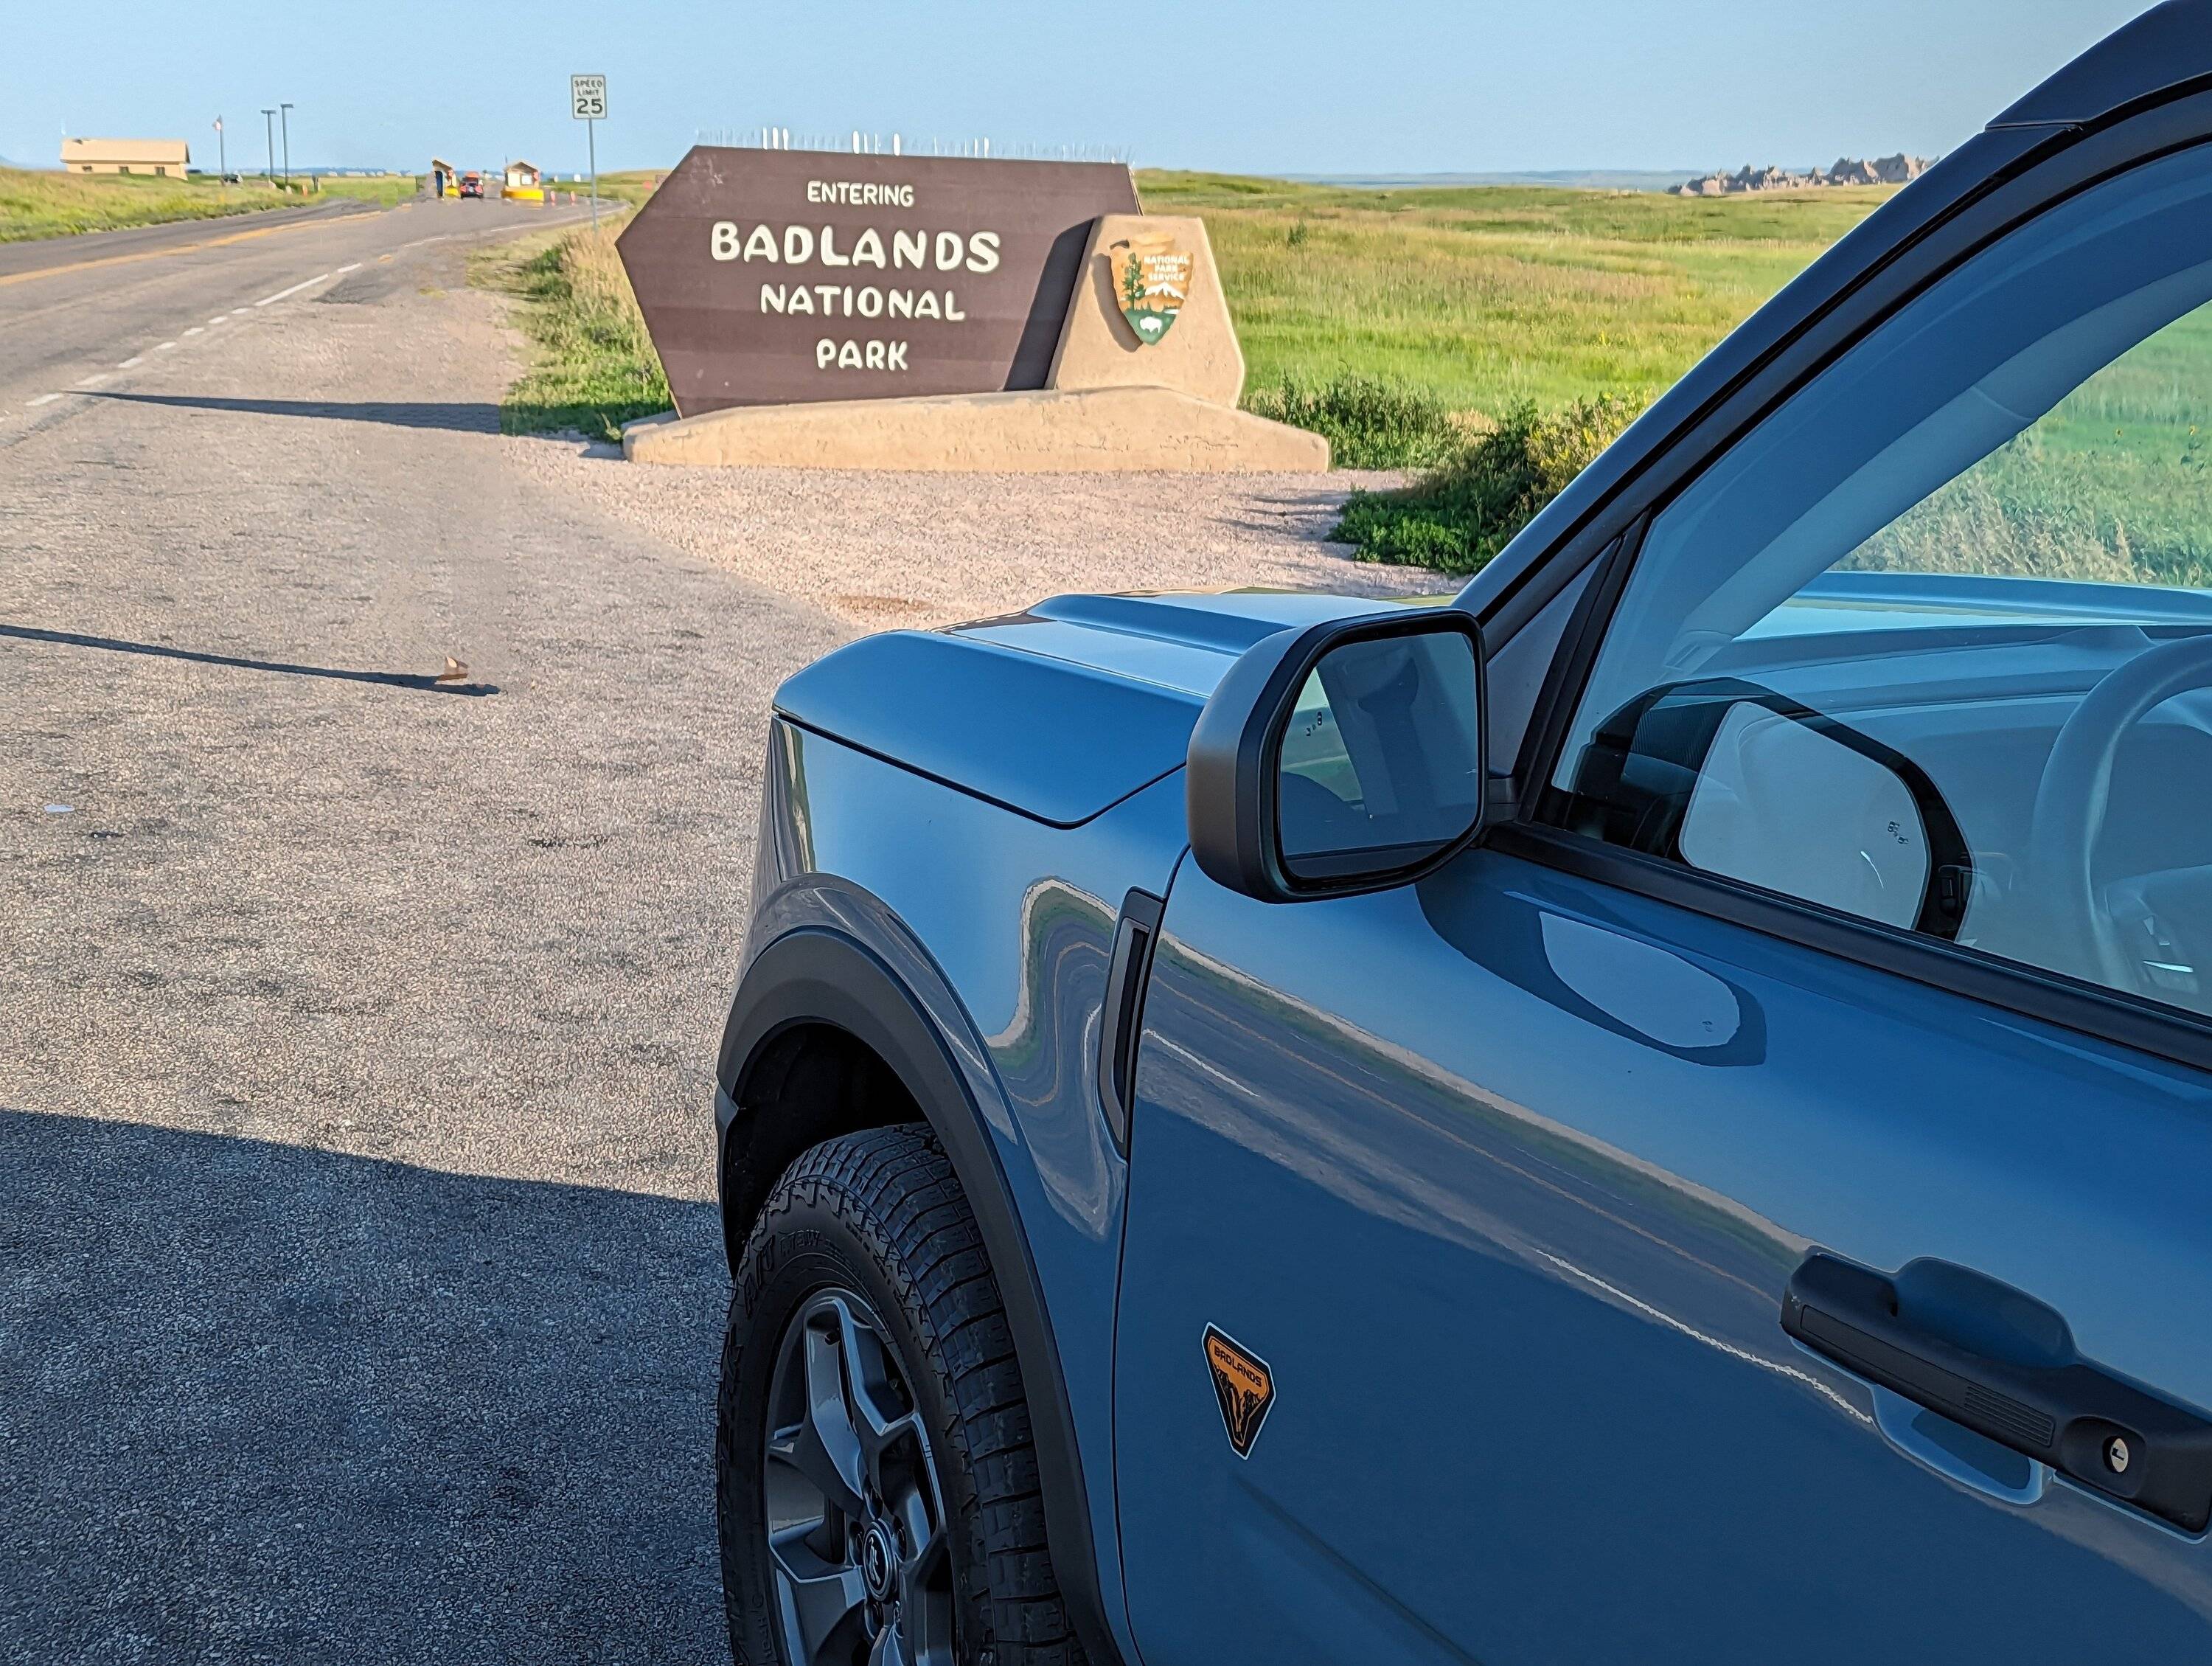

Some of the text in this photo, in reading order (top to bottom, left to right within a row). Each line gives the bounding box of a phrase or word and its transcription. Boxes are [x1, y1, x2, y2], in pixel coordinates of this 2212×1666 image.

[574, 80, 602, 88] SPEED
[577, 98, 603, 114] 25
[807, 180, 914, 208] ENTERING
[710, 221, 1001, 274] BADLANDS
[1143, 254, 1190, 265] NATIONAL
[1154, 264, 1178, 273] PARK
[1148, 272, 1185, 282] SERVICE
[760, 283, 966, 322] NATIONAL
[815, 338, 908, 371] PARK
[1214, 1344, 1262, 1388] BADLANDS
